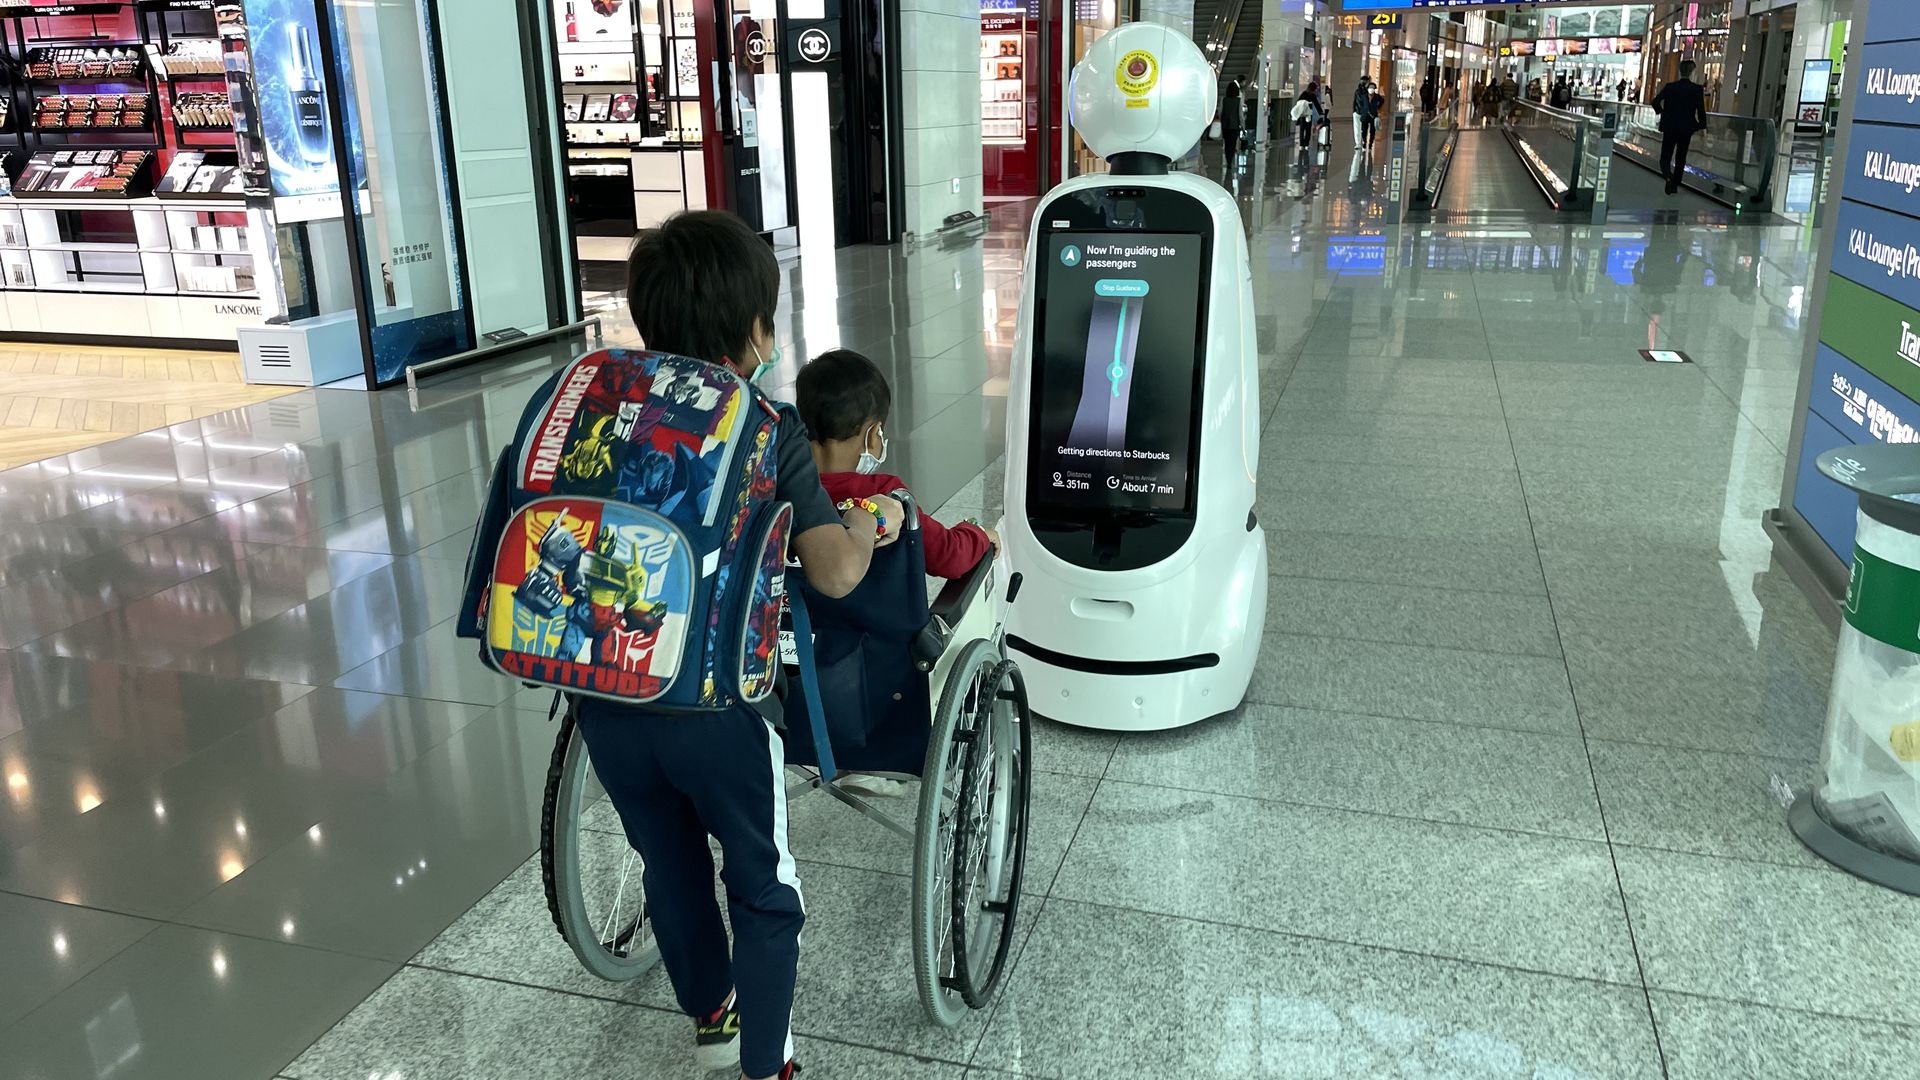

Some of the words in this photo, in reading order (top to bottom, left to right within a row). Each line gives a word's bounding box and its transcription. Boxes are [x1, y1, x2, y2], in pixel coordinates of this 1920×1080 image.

[1866, 68, 1885, 94] KAL
[1864, 151, 1883, 180] KAL
[1884, 153, 1920, 191] Lounge
[1086, 245, 1107, 255] Now
[1109, 245, 1123, 255] I'm
[1124, 245, 1158, 257] guiding
[1160, 245, 1176, 256] the
[1849, 228, 1866, 258] KAL
[1867, 233, 1903, 277] Lounge
[1085, 258, 1137, 269] passengers
[1102, 284, 1115, 292] Stop
[1115, 284, 1142, 292] Guidance
[214, 304, 263, 315] LANCÔME
[529, 364, 599, 482] TRANSFORMERS
[1057, 446, 1085, 457] Getting
[1085, 447, 1122, 458] directions
[1123, 450, 1132, 458] to
[1132, 450, 1170, 460] Starbucks
[1066, 471, 1092, 479] Distance
[1066, 480, 1090, 490] 351m
[1121, 482, 1148, 493] About
[1150, 484, 1156, 493] 7
[1157, 484, 1174, 495] min
[501, 650, 661, 699] ATTITUDE
